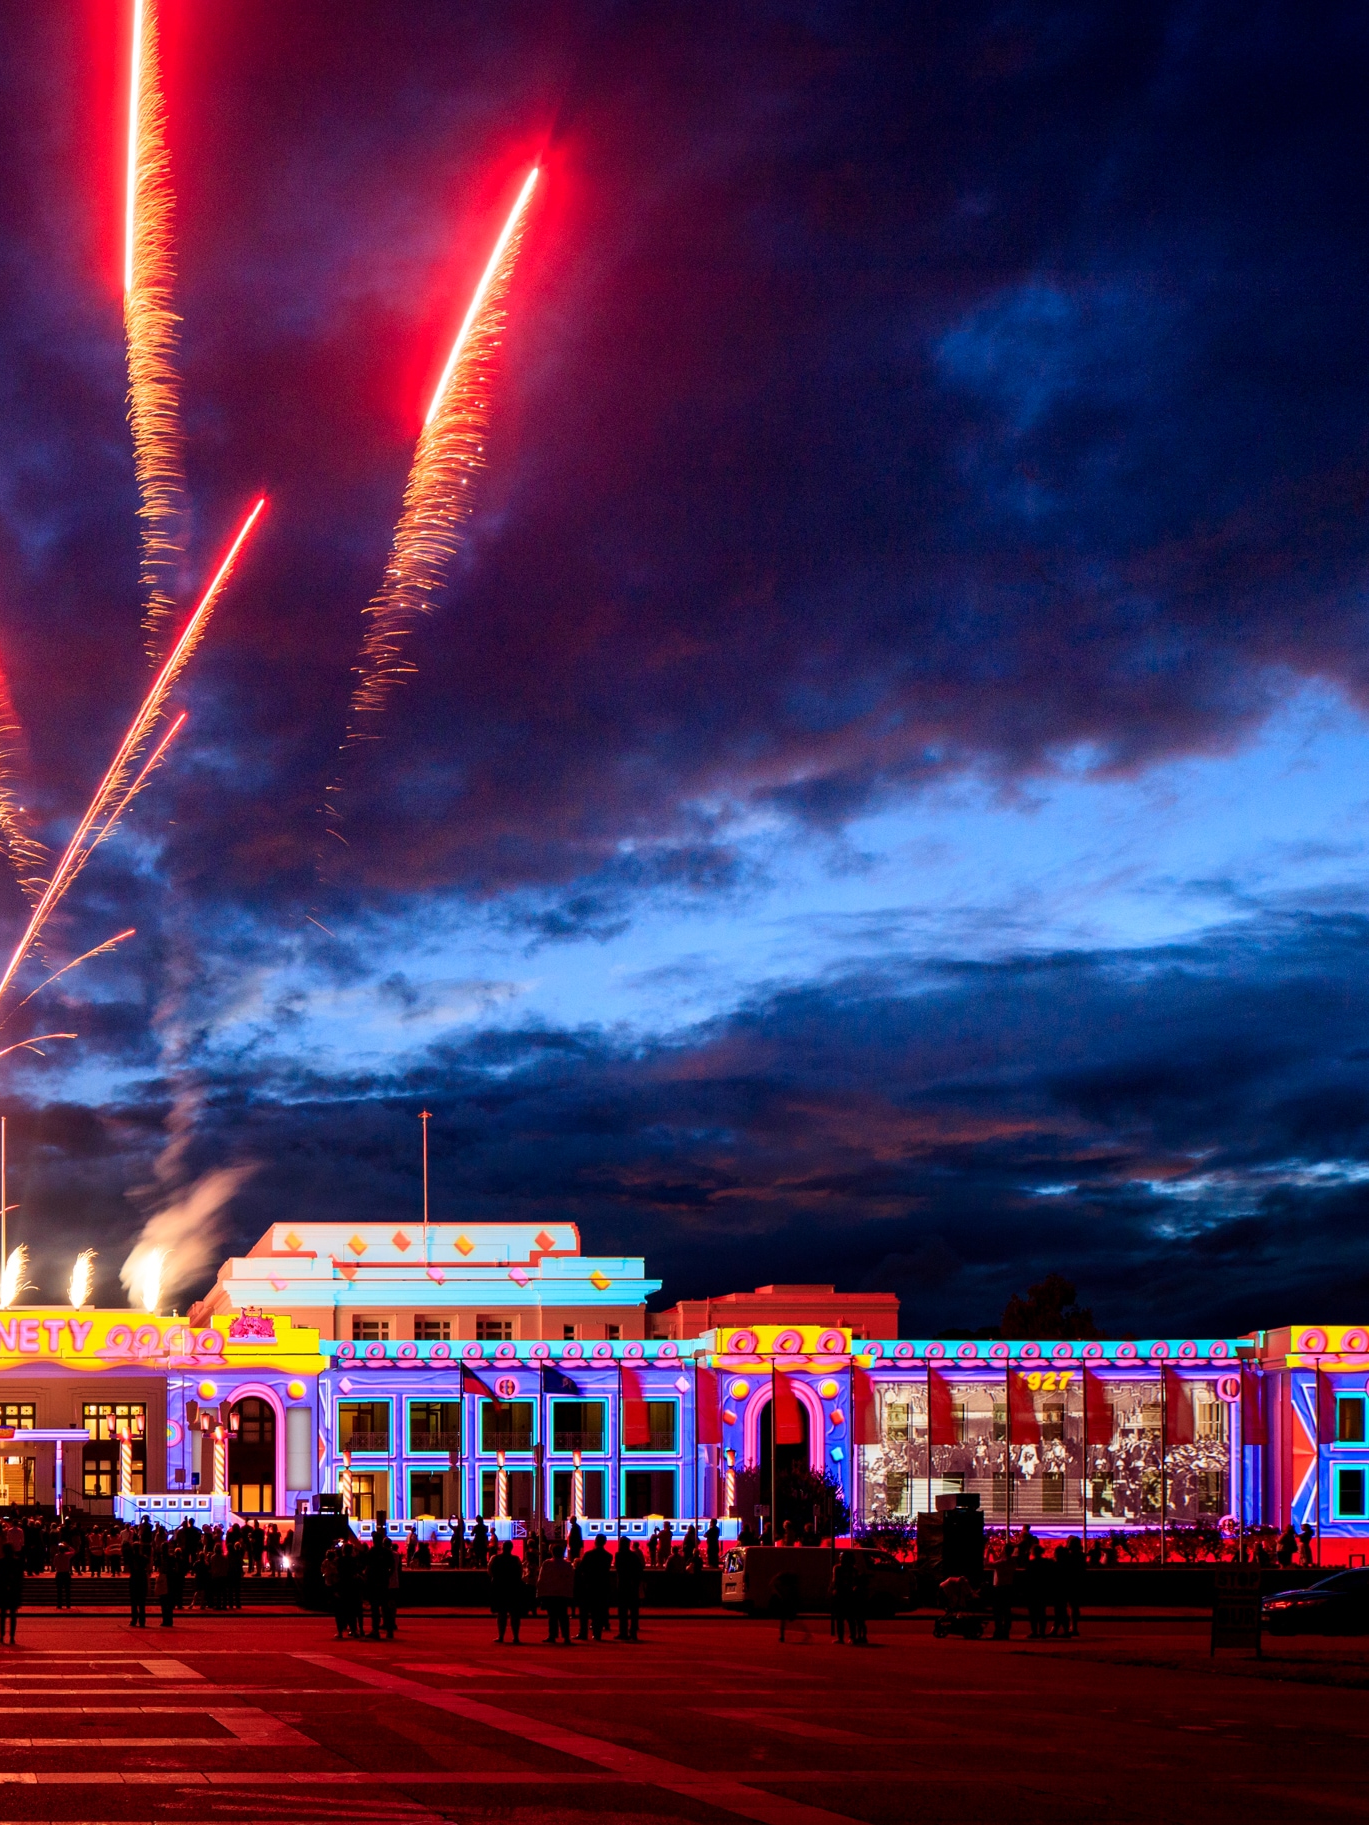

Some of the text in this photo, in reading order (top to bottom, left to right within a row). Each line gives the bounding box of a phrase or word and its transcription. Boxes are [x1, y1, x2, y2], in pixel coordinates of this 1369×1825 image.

[1018, 1372, 1073, 1391] 927
[1217, 1571, 1259, 1587] STOP
[1217, 1608, 1256, 1626] OUR
